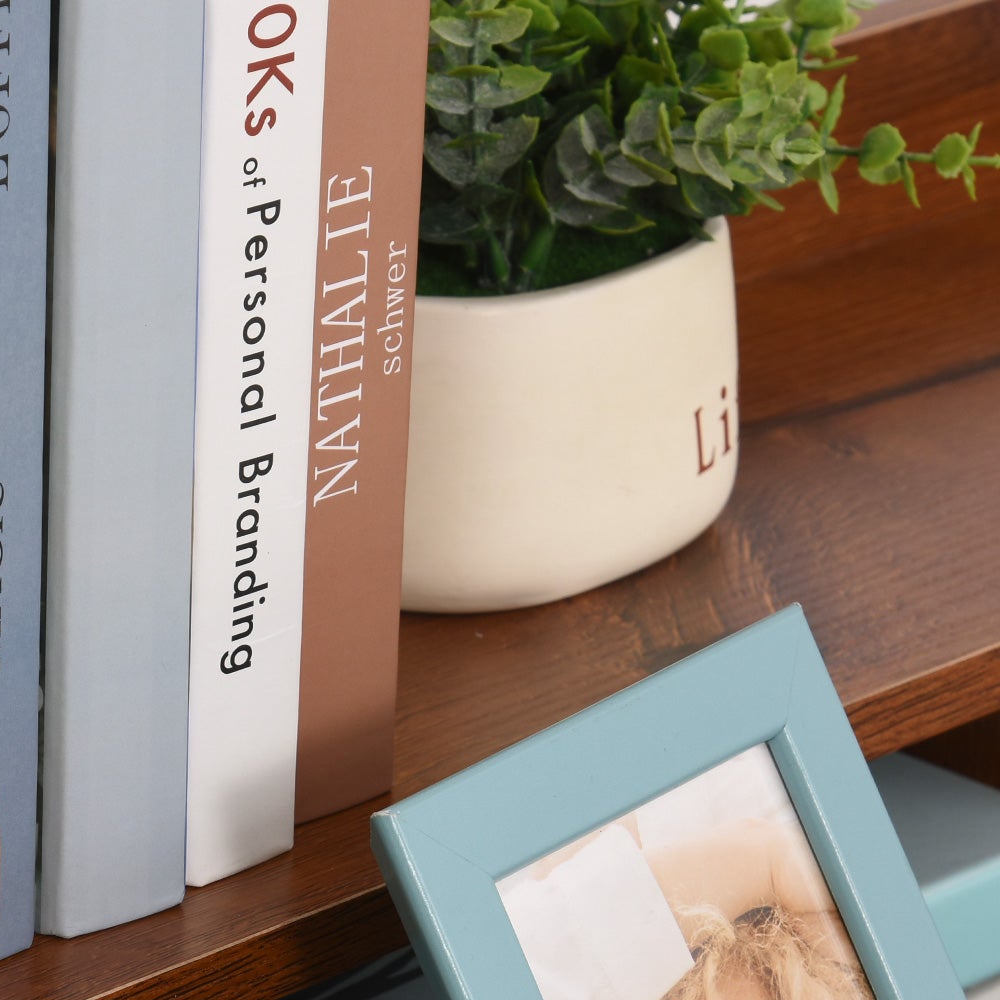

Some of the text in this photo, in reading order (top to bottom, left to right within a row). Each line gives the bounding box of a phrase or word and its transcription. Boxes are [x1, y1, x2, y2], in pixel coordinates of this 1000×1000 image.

[242, 157, 267, 188] of
[240, 199, 282, 430] Personal
[313, 165, 373, 508] NATHALIE
[376, 240, 407, 375] schwer
[219, 452, 275, 675] Branding
